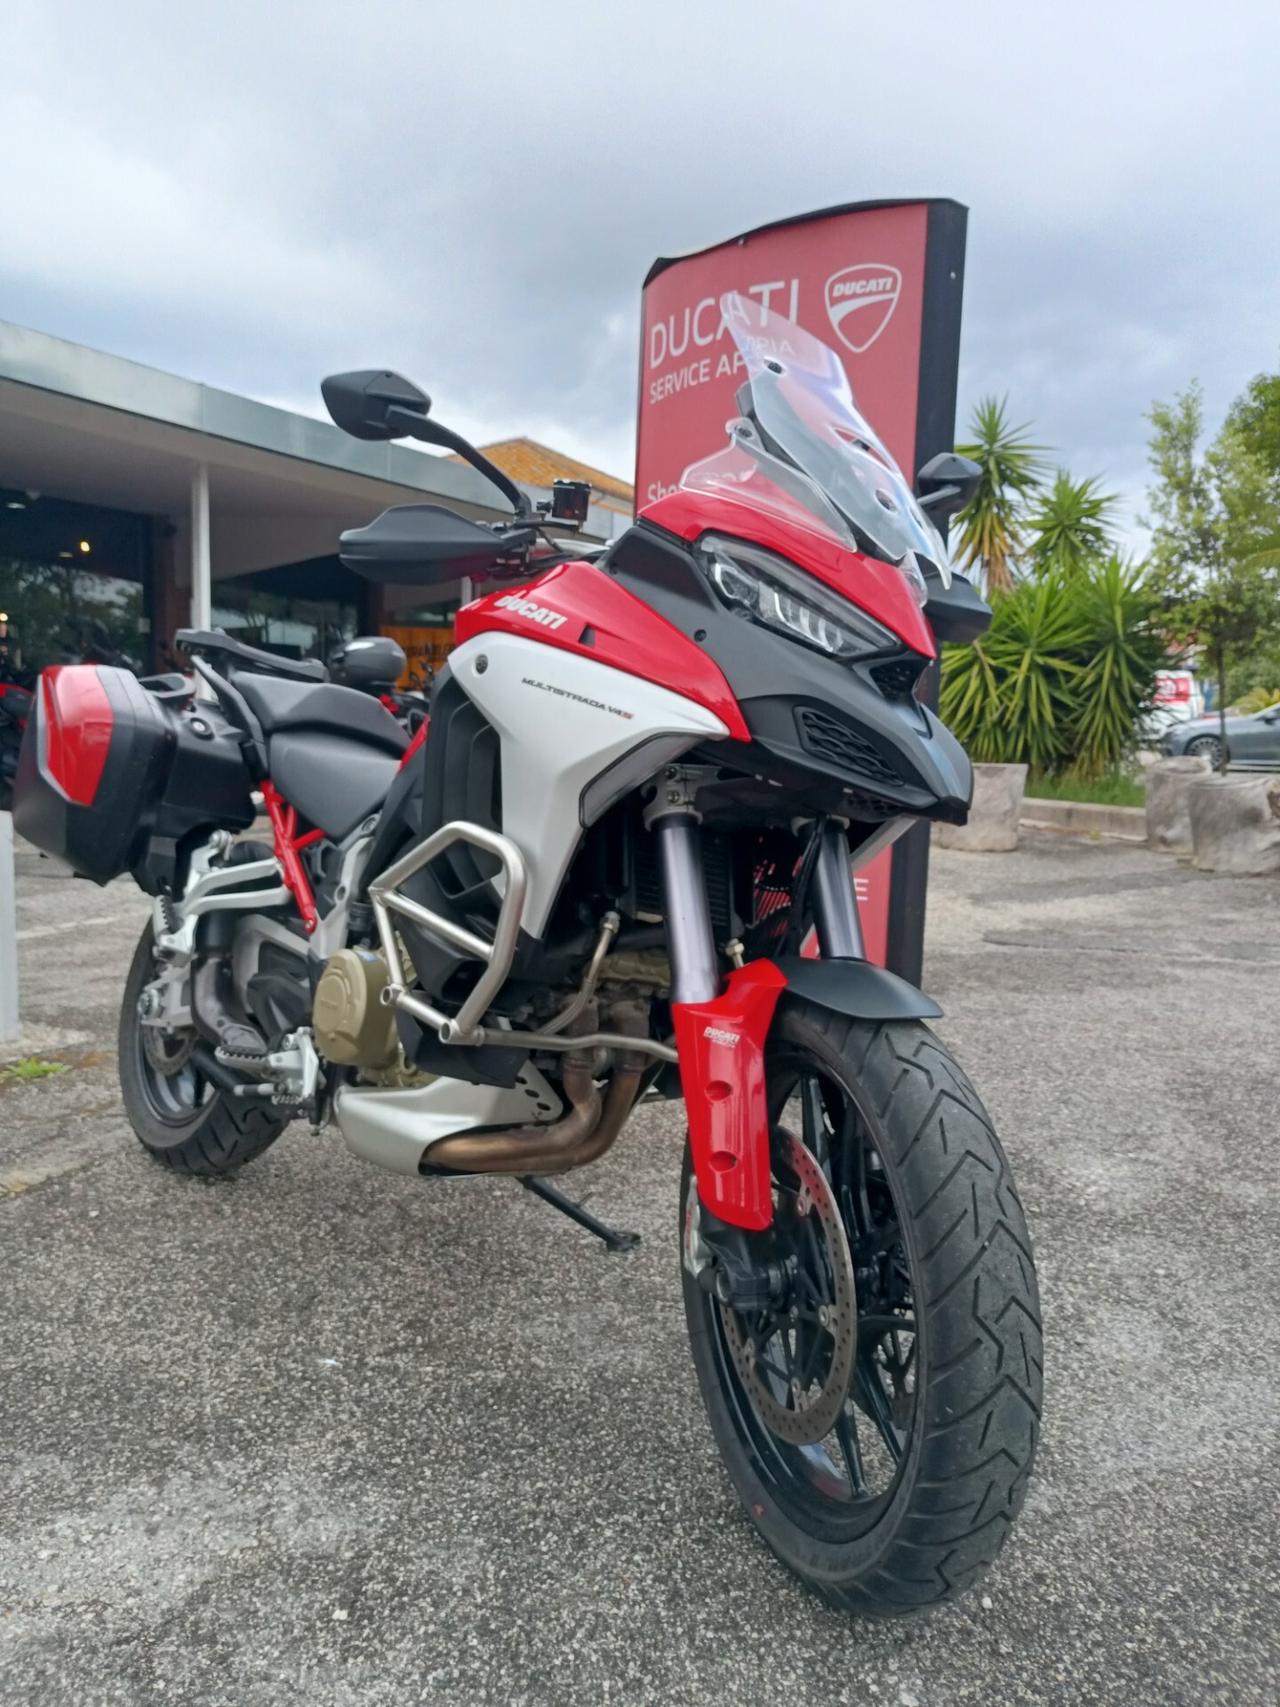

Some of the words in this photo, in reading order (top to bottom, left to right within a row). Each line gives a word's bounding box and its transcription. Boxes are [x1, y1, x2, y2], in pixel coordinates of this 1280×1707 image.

[832, 276, 894, 298] DUCATI
[650, 278, 800, 370] DUCATI
[649, 358, 711, 405] SERVICE
[493, 595, 569, 631] DUCATI
[521, 677, 606, 711] MULTISTRADA
